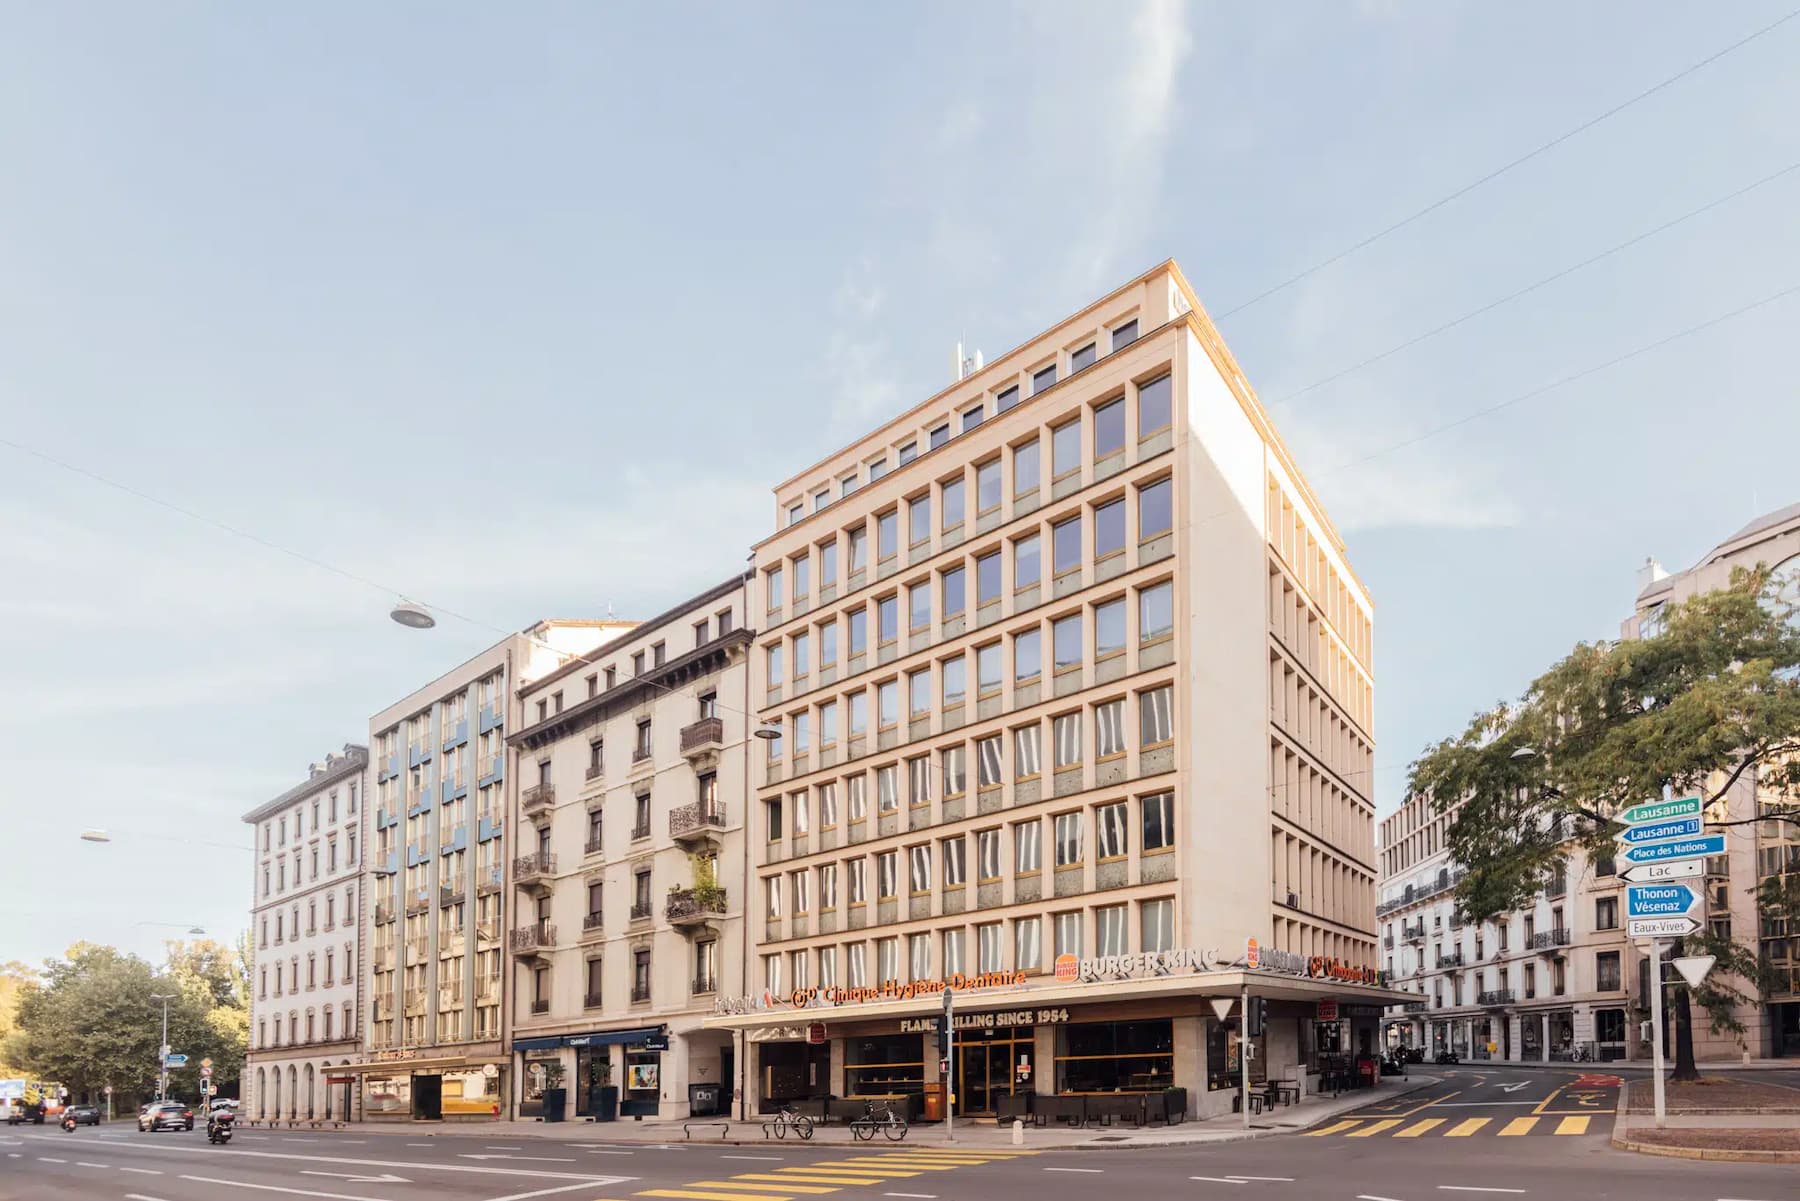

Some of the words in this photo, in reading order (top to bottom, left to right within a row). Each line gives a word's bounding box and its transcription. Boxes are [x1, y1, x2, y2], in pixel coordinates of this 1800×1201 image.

[1633, 801, 1696, 821] Lausanne
[1630, 824, 1685, 841] Lausanne
[1633, 848, 1656, 860] Place
[1657, 845, 1672, 856] des
[1674, 842, 1708, 855] Nations
[1649, 865, 1671, 877] Lac
[1636, 888, 1678, 899] Thonon
[1634, 901, 1680, 913] Vésenaz
[1634, 921, 1686, 934] Eaux-Vives
[1079, 952, 1159, 978] BURGER
[1163, 947, 1219, 970] KING
[1056, 968, 1077, 977] KING
[824, 985, 879, 1006] Clinique
[883, 978, 946, 1000] Hygiène
[952, 970, 1026, 991] Dentaire
[952, 1014, 994, 1029] ILLING
[996, 1011, 1034, 1026] SINCE
[1037, 1008, 1069, 1024] 1954
